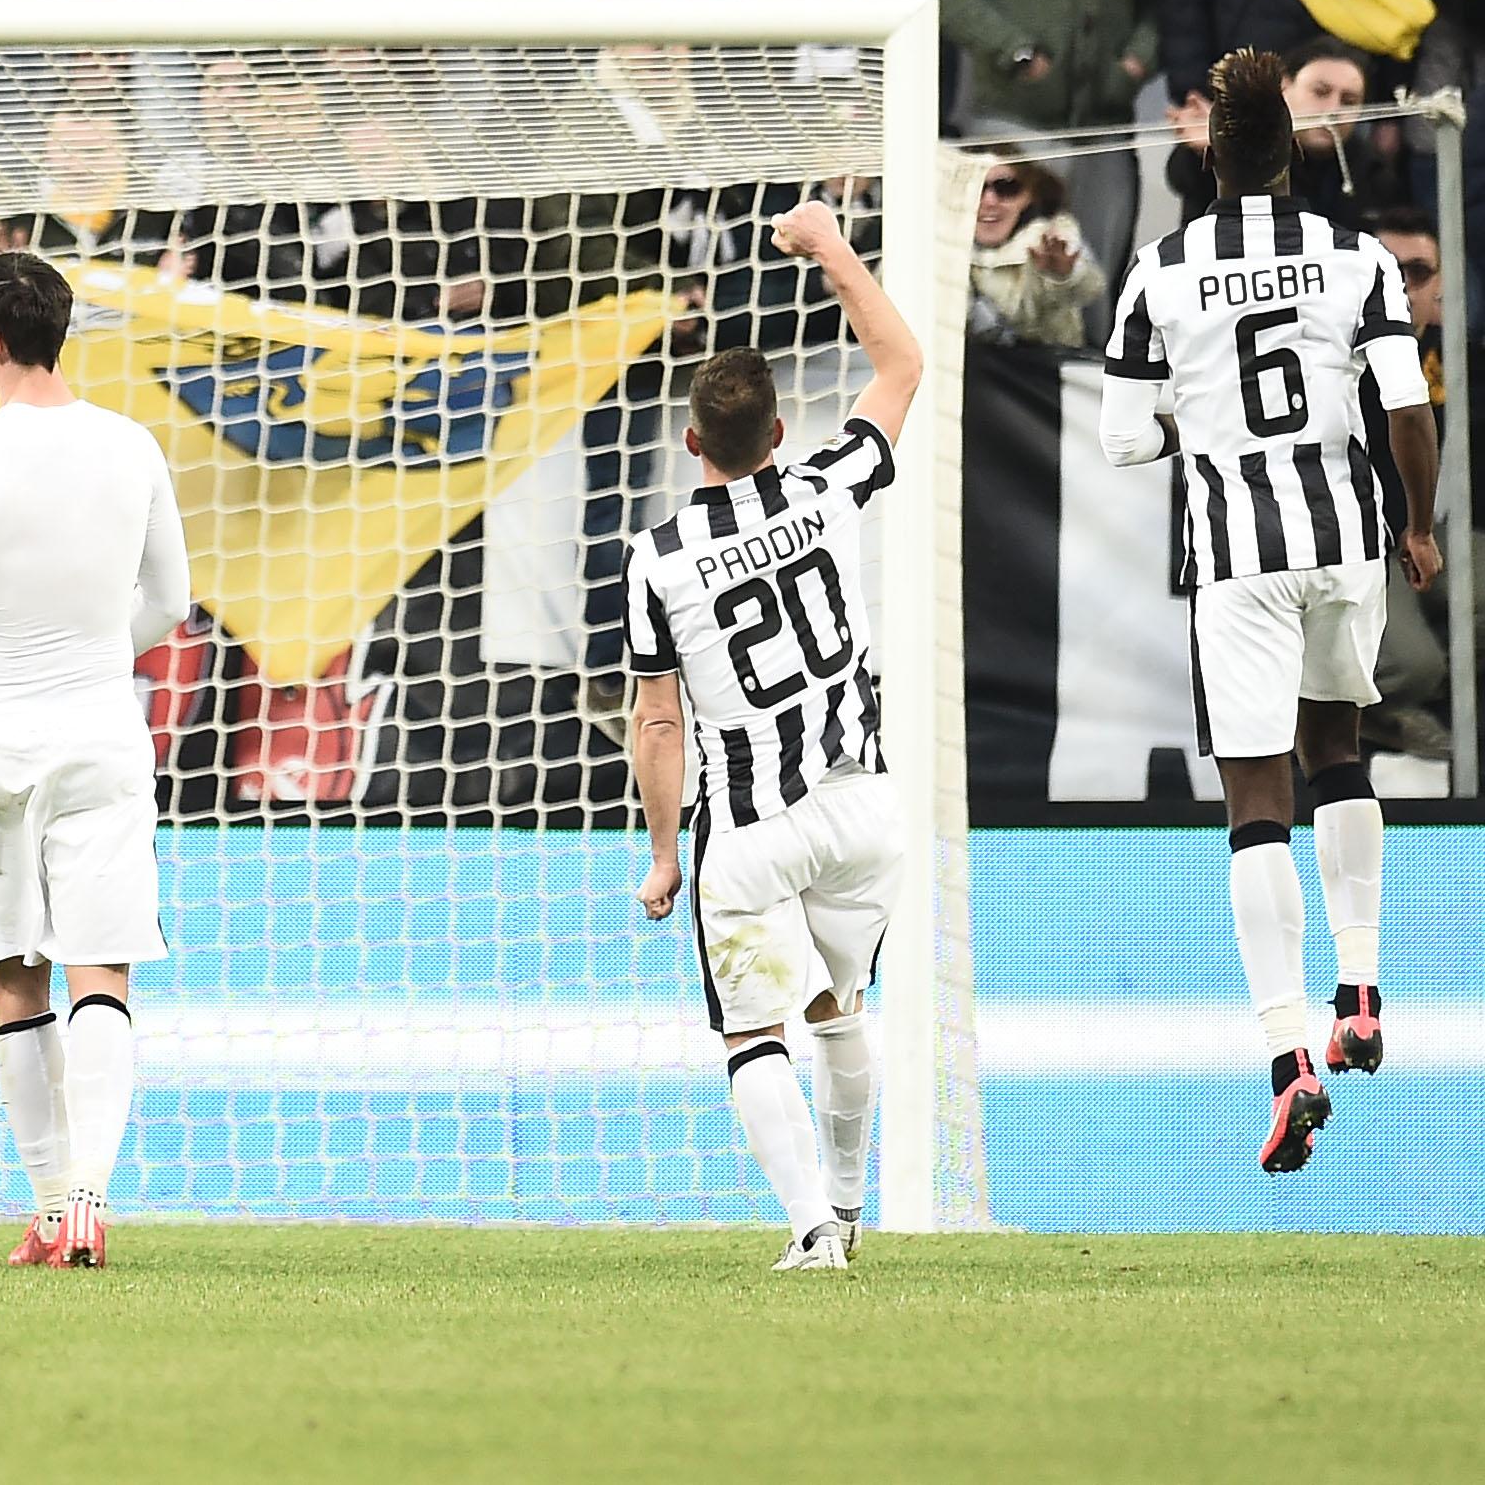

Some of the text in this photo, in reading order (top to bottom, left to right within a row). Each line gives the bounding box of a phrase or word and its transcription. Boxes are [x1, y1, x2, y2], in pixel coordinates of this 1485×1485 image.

[1200, 264, 1326, 312] POGBA
[1235, 308, 1308, 438] 6
[696, 510, 826, 589] PADOIN
[713, 547, 854, 710] 20
